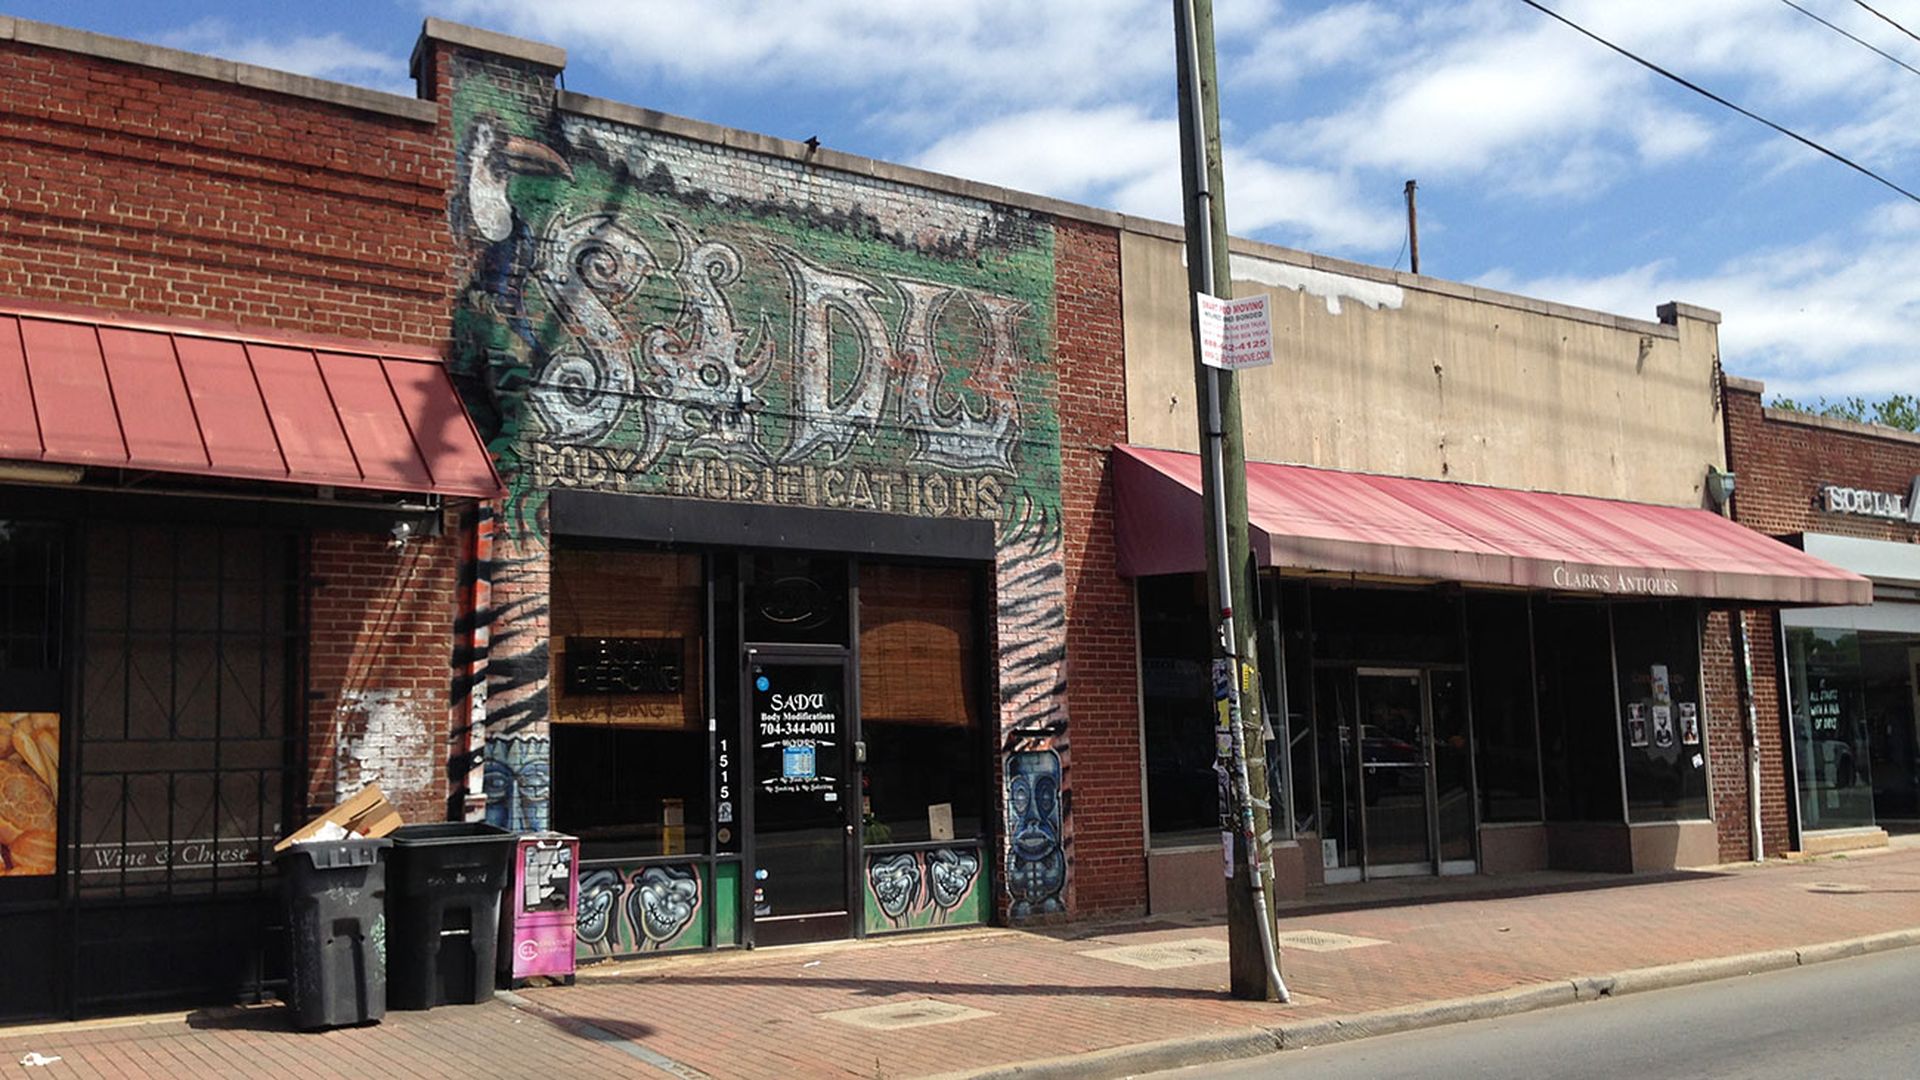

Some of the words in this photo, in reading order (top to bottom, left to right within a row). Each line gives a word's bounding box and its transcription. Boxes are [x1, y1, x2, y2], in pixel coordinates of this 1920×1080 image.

[1233, 301, 1264, 314] MOVING
[1236, 311, 1263, 322] BONDED
[534, 443, 638, 491] BODY
[672, 459, 1004, 518] MODIFICATIONS
[1824, 486, 1908, 519] SOCIAL
[1617, 573, 1679, 594] ANTIQUES
[770, 693, 824, 711] SADU
[761, 712, 780, 722] Body
[783, 712, 835, 721] Modifications
[760, 722, 835, 735] 704-344-0011
[719, 739, 729, 799] 1515
[95, 850, 147, 867] Wine
[182, 845, 249, 864] Cheese
